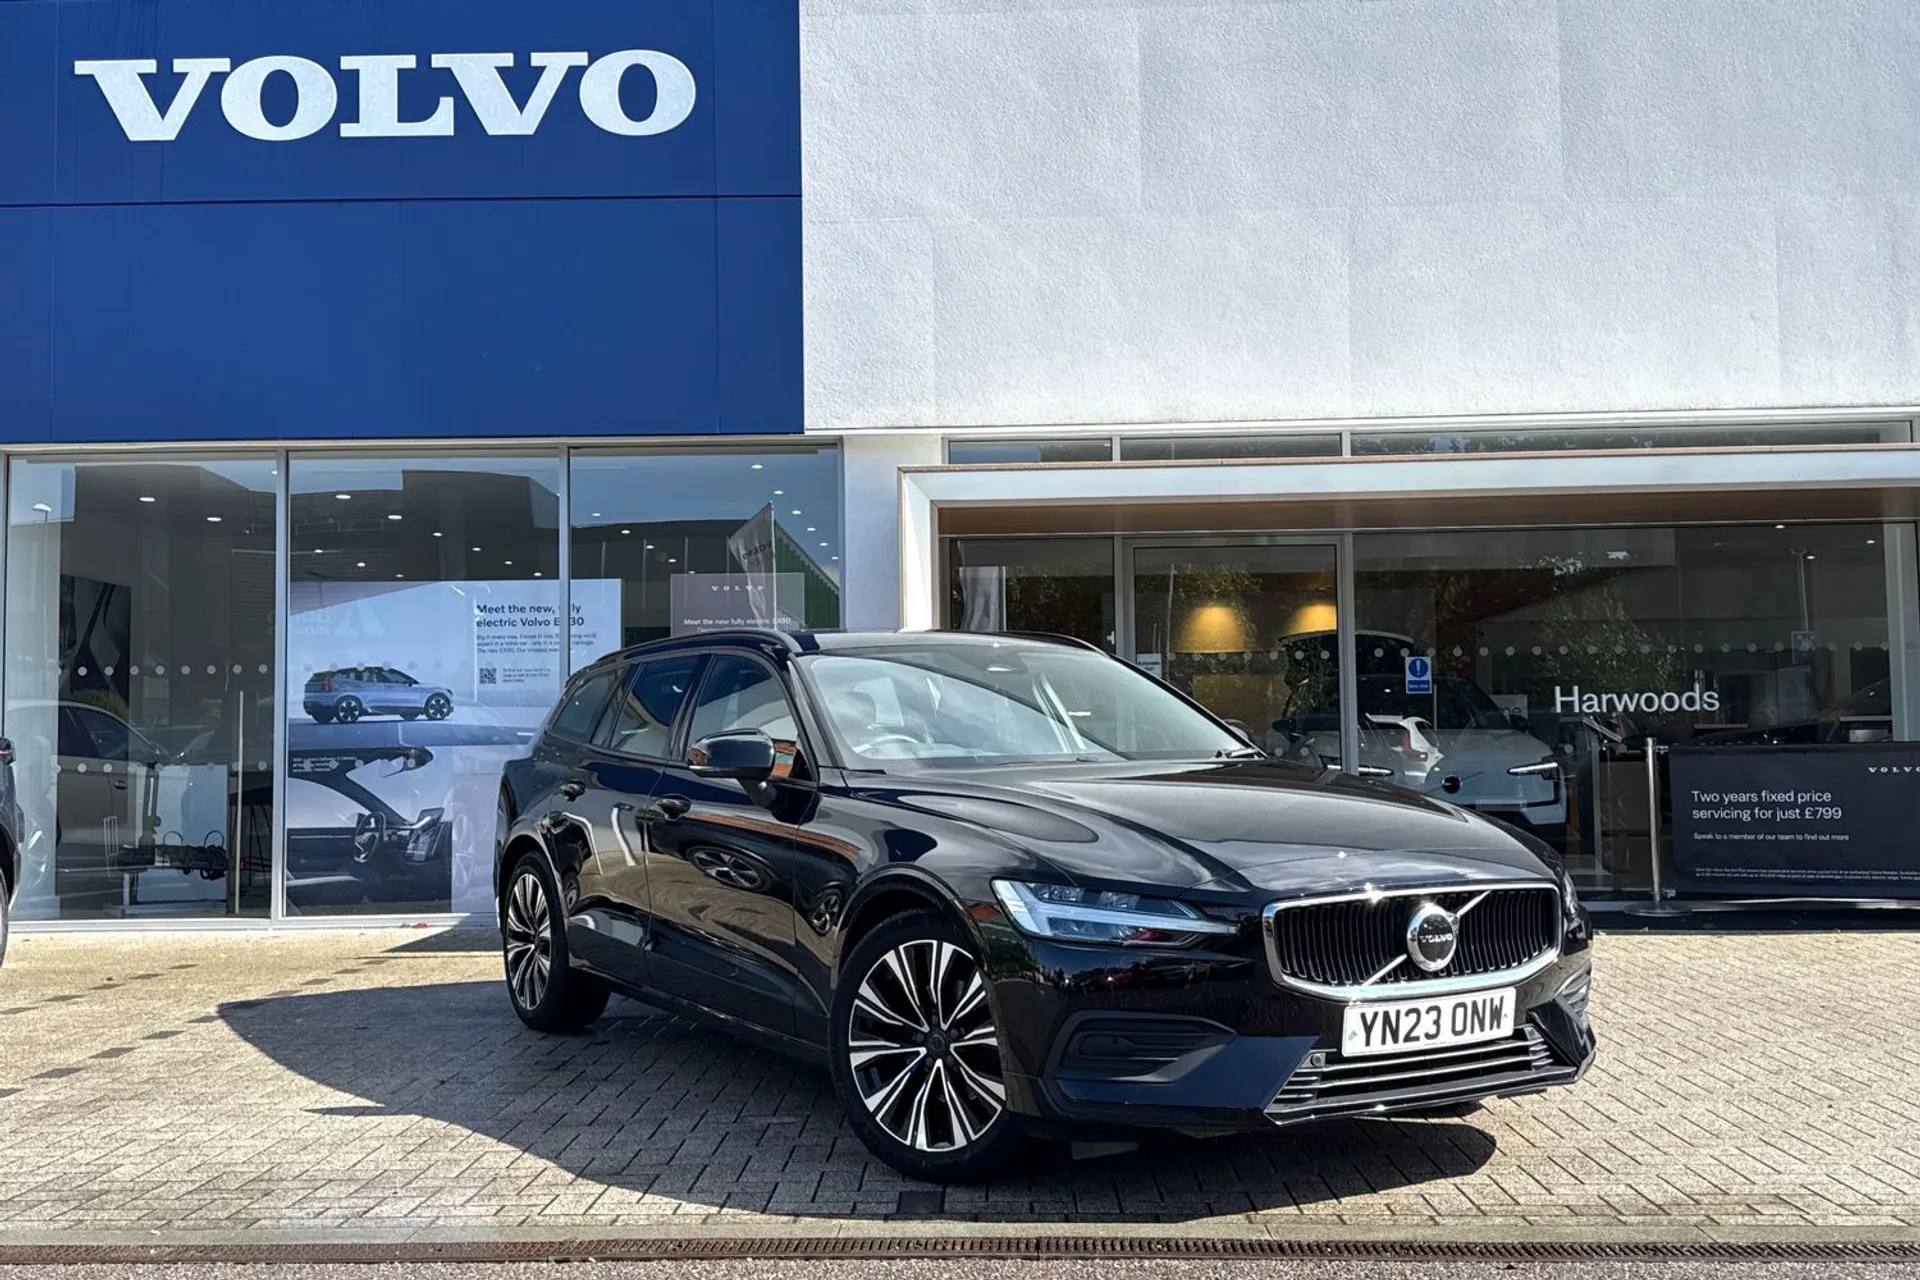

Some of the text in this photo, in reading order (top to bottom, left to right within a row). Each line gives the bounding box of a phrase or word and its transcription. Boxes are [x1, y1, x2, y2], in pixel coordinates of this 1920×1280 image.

[74, 49, 696, 141] VOLVO
[476, 604, 505, 614] Meet
[508, 604, 526, 614] the
[529, 604, 555, 614] new,
[476, 616, 585, 627] electric Volvo E30
[1554, 682, 1720, 713] Harwoods
[1691, 790, 1832, 805] Two years fixed price
[1692, 807, 1842, 822] servicing for just £799
[1693, 833, 1714, 841] Speak
[1796, 833, 1803, 841] to
[1804, 833, 1818, 841] find
[1419, 933, 1453, 943] VOLVO
[1360, 995, 1505, 1047] YN23 ONW
